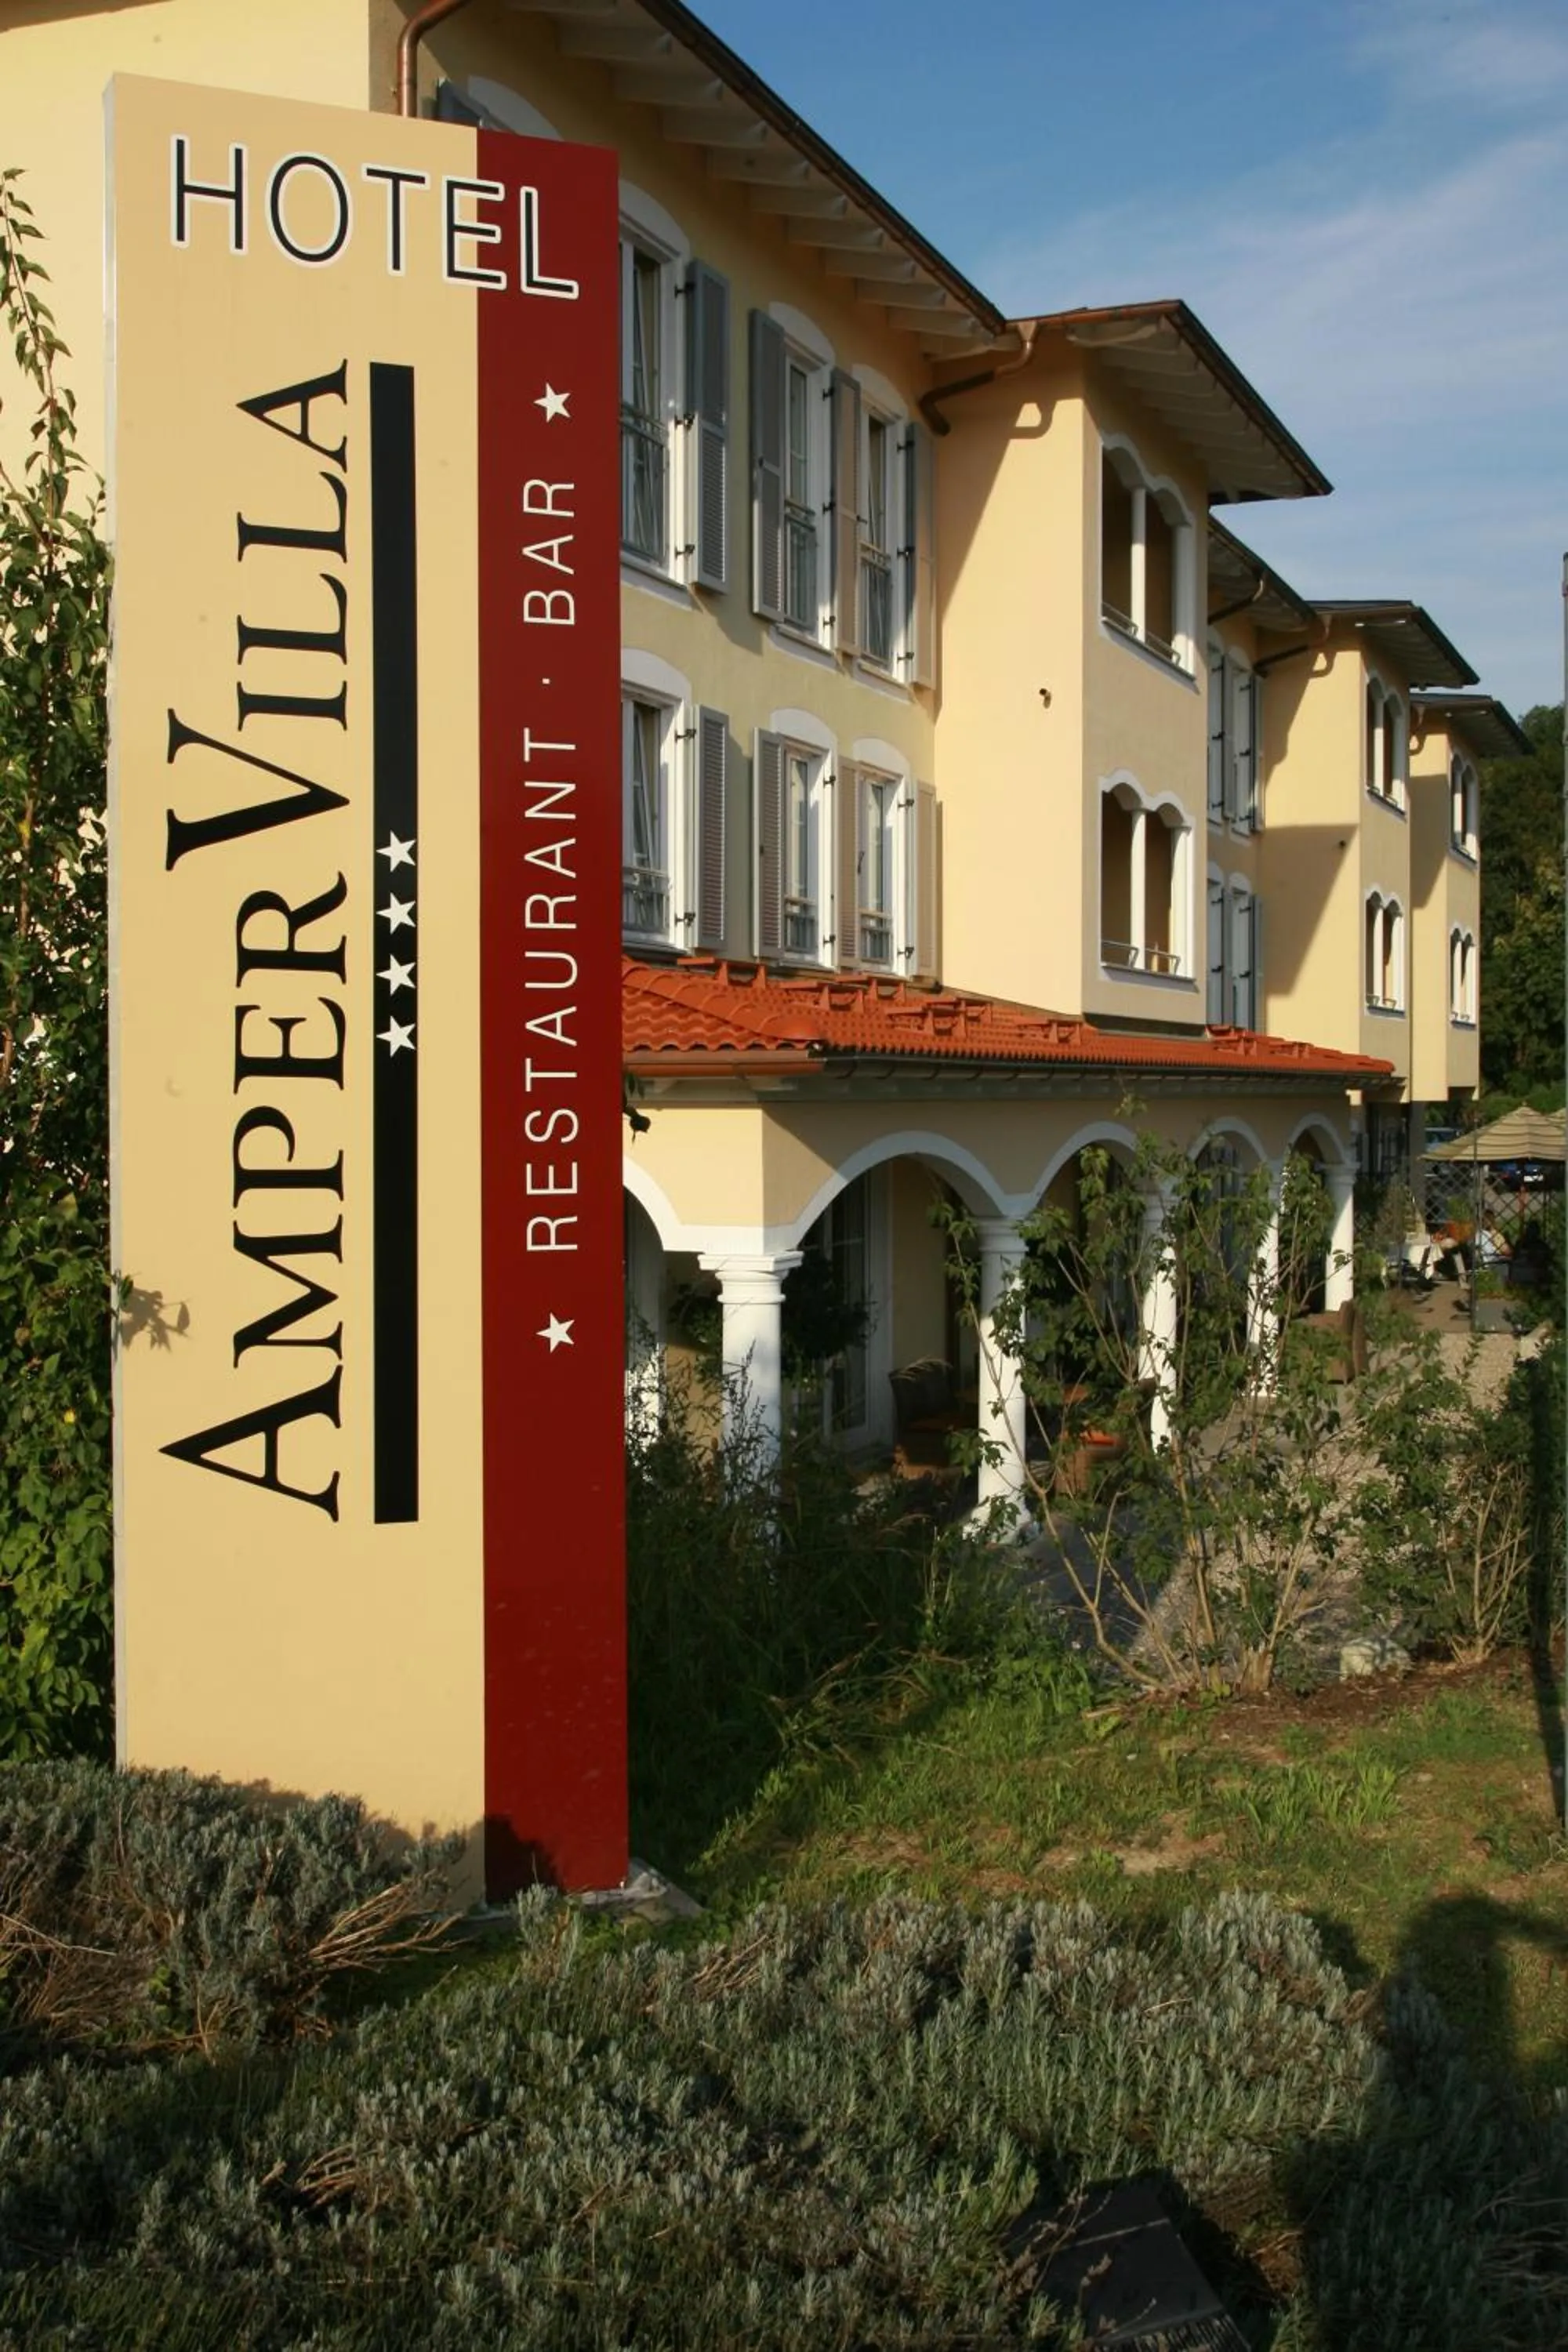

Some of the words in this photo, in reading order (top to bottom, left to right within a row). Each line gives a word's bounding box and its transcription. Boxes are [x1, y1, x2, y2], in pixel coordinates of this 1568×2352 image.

[170, 133, 579, 299] HOTEL
[522, 478, 575, 626] BAR
[523, 728, 579, 1252] RESTAURANT
